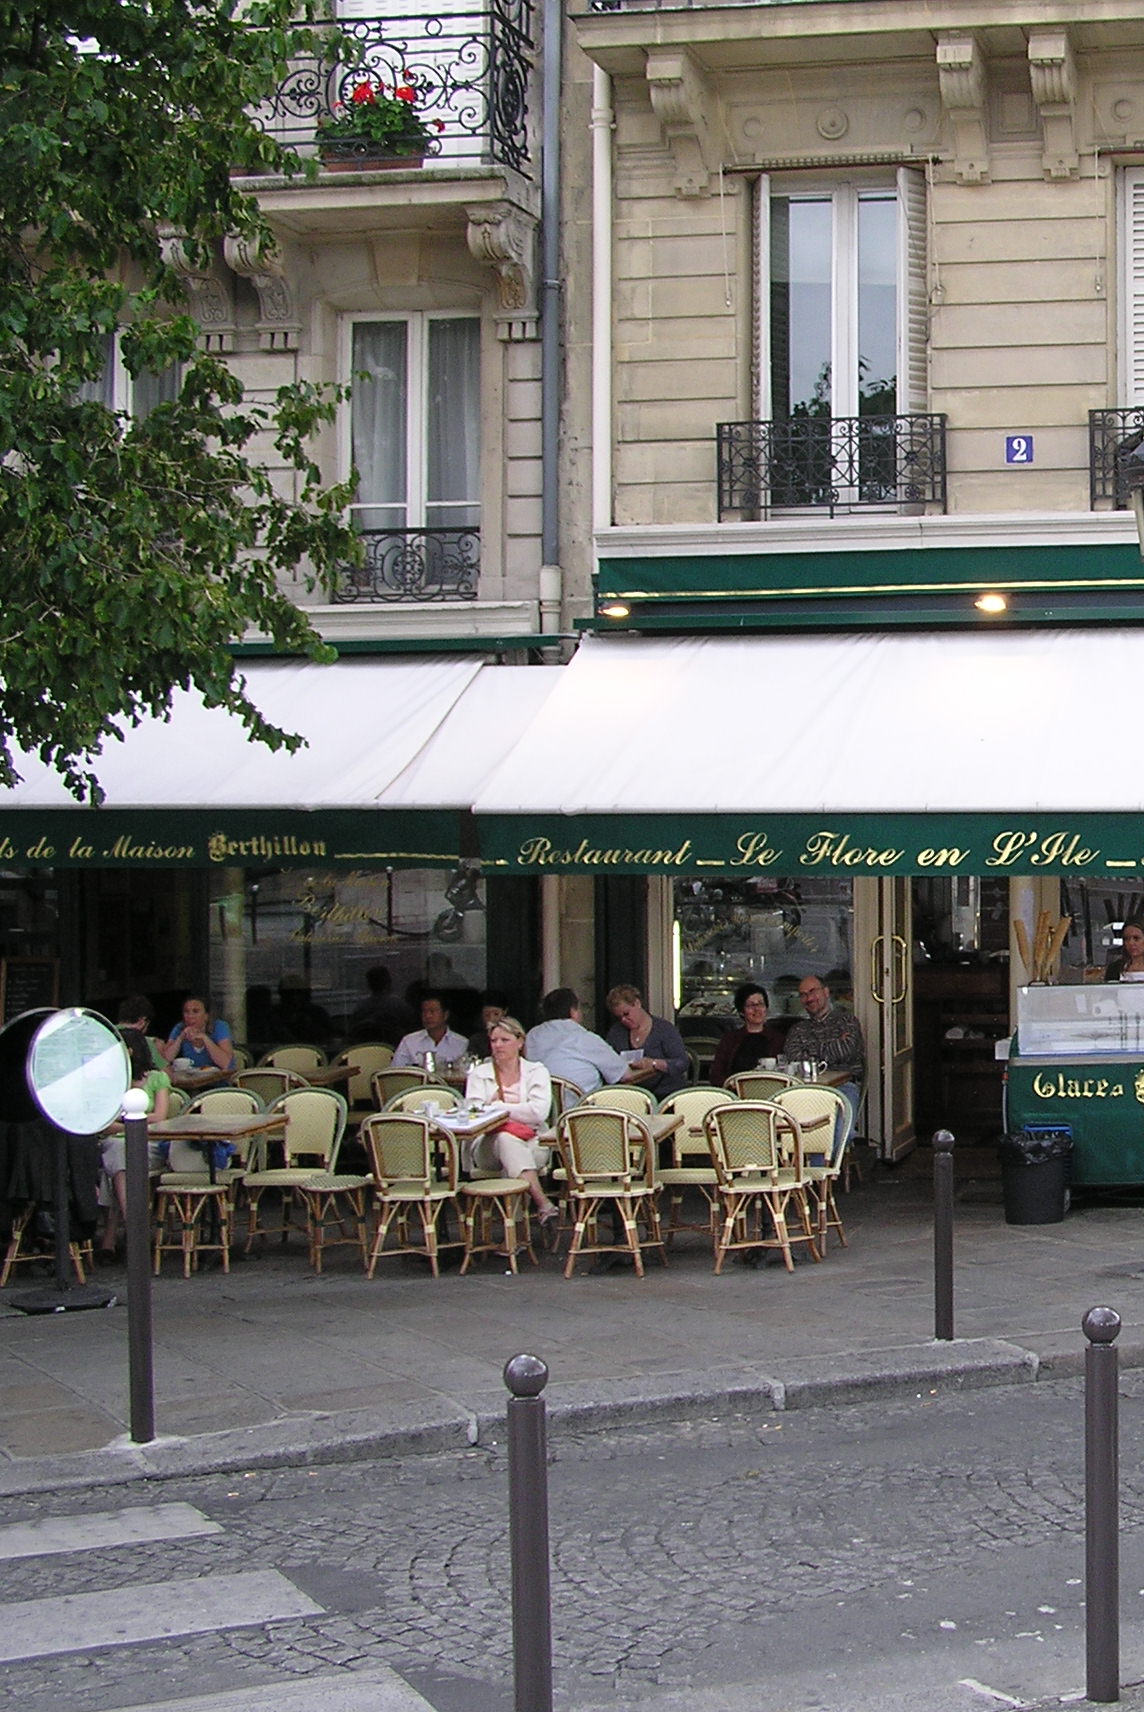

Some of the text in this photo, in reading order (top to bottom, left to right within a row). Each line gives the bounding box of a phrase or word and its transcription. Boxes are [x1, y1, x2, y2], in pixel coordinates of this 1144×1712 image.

[1012, 438, 1027, 461] 2
[26, 836, 56, 859] de
[69, 836, 95, 858] la
[103, 836, 193, 858] Maison
[208, 831, 326, 861] Berthillon
[518, 838, 691, 864] Restaurant
[730, 832, 1100, 866] Le Flore en L'Ile
